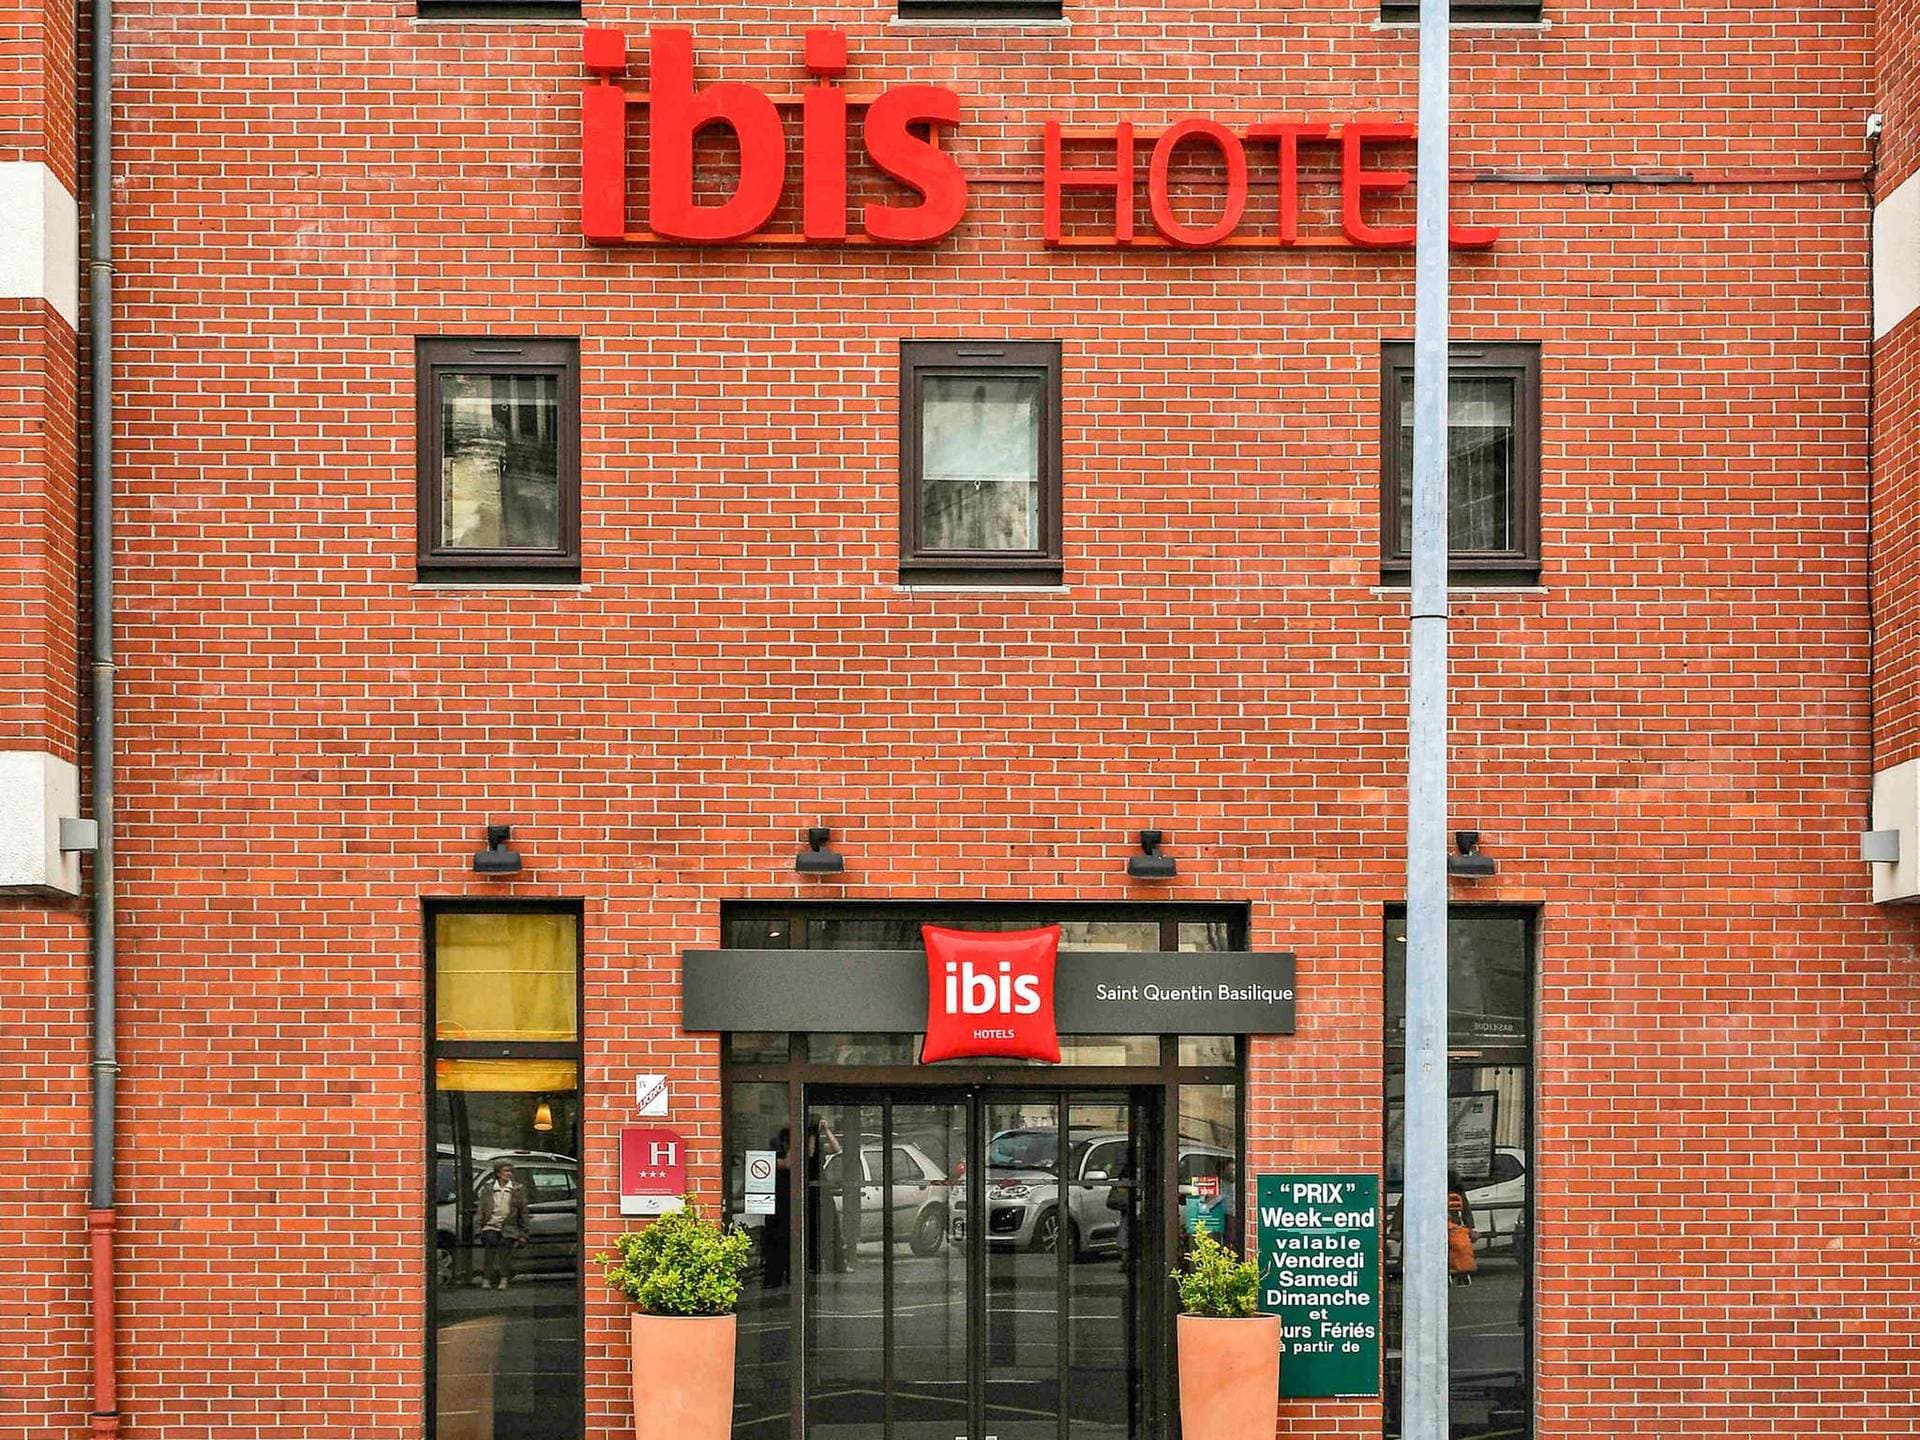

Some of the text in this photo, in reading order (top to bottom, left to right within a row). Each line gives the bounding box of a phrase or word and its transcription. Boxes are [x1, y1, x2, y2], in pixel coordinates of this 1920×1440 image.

[581, 29, 968, 246] ibis
[946, 961, 1041, 1015] ibis
[1096, 984, 1294, 1005] Saint Quentin Basilique
[973, 1029, 1015, 1039] HOTELS
[648, 1142, 679, 1166] H
[1260, 1206, 1375, 1228] Week-end
[1275, 1235, 1361, 1250] valable
[1272, 1252, 1364, 1269] Vendredi
[1279, 1270, 1358, 1287] Samedi
[1266, 1289, 1370, 1306] Dimanche
[1308, 1308, 1329, 1320] et
[1279, 1321, 1375, 1339] urs Fériés
[1293, 1340, 1335, 1355] partir
[1341, 1340, 1360, 1353] de
